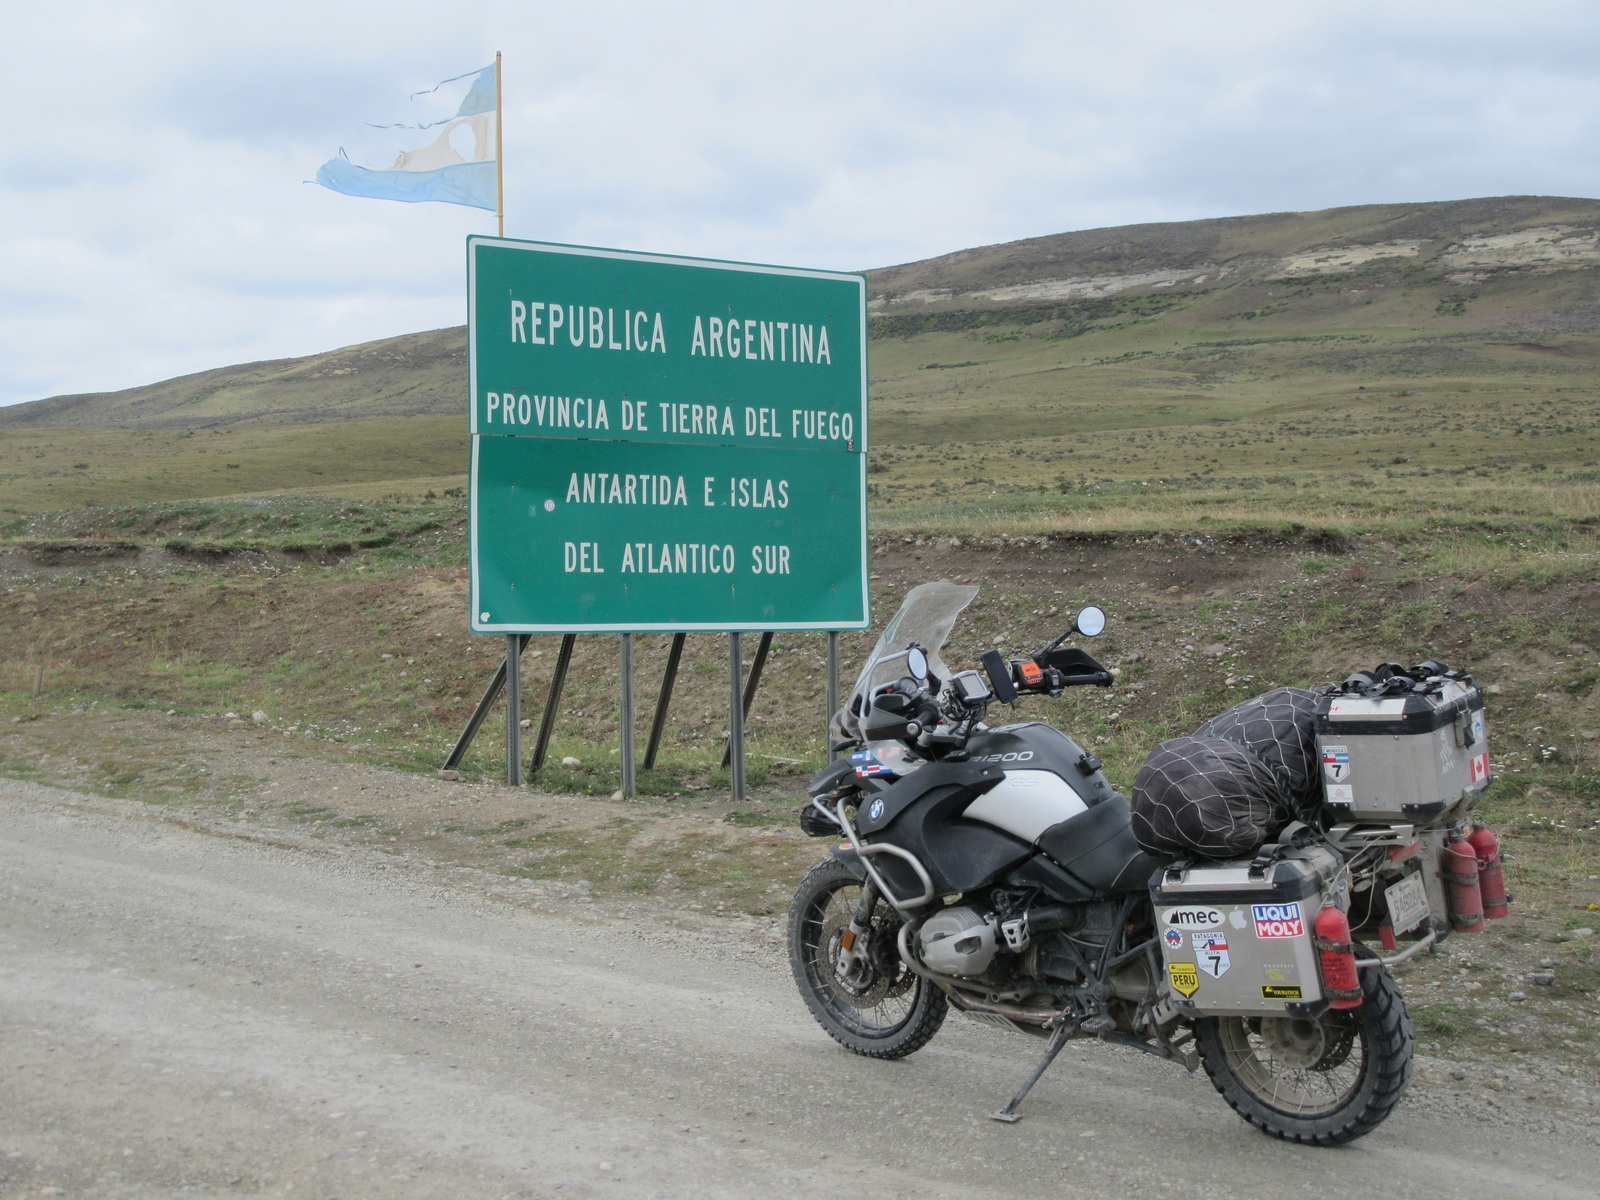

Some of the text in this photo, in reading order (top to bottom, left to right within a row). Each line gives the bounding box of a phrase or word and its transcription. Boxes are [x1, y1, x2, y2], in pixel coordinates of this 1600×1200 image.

[511, 300, 831, 365] REPUBLICA ARGENTINA
[486, 392, 853, 441] PROVINCIA DE TIERRA DEL FUEGO
[565, 473, 789, 508] ANTARTIDA E ISLAS
[564, 542, 790, 575] DEL ATLANTICO SUR
[1331, 764, 1342, 778] 7
[1179, 910, 1219, 924] mec
[1254, 904, 1299, 921] LIQUI
[1194, 932, 1223, 940] PATAGONIA
[1257, 919, 1300, 936] MOLY
[1207, 955, 1221, 976] 7
[1173, 974, 1196, 986] PERU
